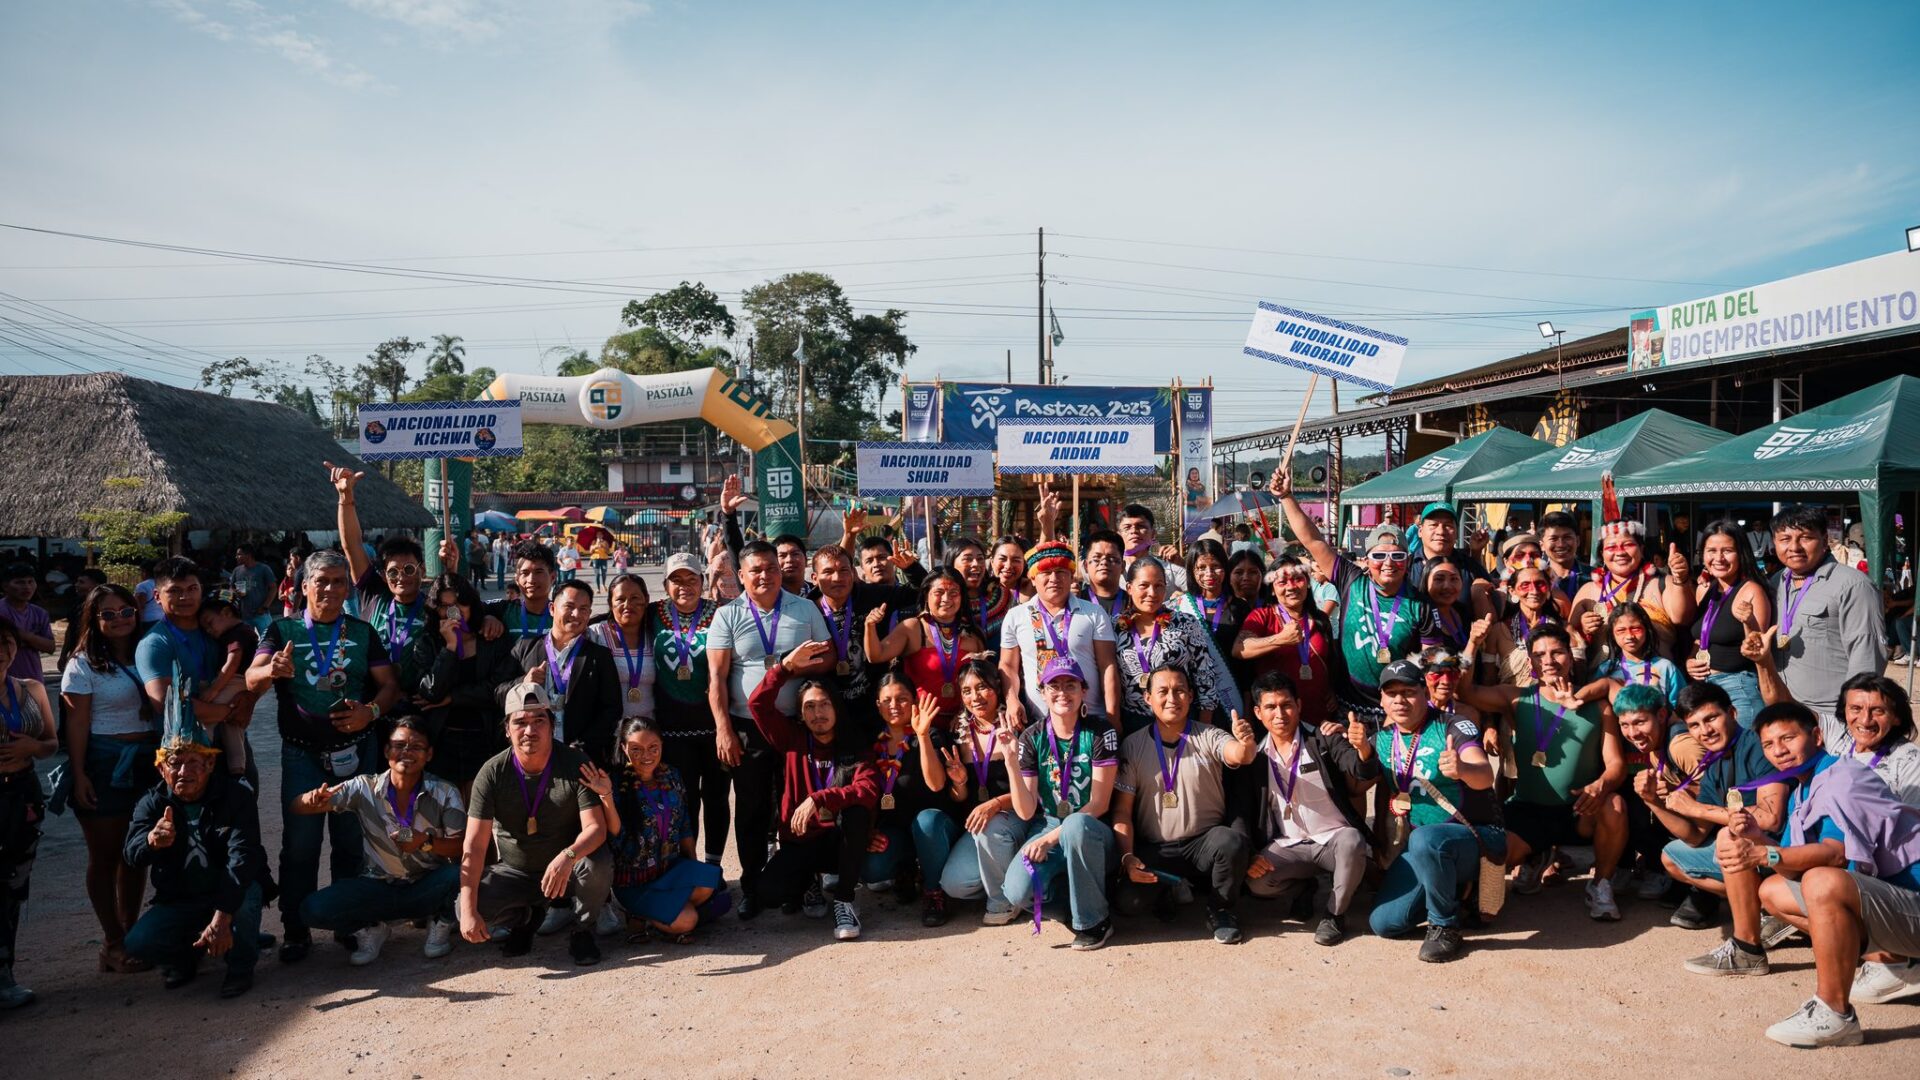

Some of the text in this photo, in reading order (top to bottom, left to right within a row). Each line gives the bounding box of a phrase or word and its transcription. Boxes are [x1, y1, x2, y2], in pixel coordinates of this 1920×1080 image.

[1671, 290, 1759, 330] RUTA DEL
[1669, 291, 1917, 361] BIOEMPRENDIMIENTO
[1275, 320, 1380, 357] NACIONALIDAD
[1290, 340, 1356, 368] WAORANI
[519, 390, 566, 403] PASTAZA
[646, 386, 694, 401] PASTAZA
[1106, 400, 1152, 418] 2025
[386, 414, 497, 431] NACIONALIDAD
[413, 431, 471, 446] KICHWA
[1022, 431, 1129, 445] NACIONALIDAD
[1049, 447, 1101, 460] ANDWA
[880, 455, 972, 468] NACIONALIDAD
[907, 470, 950, 483] SHUAR
[765, 506, 799, 517] PASTAZA
